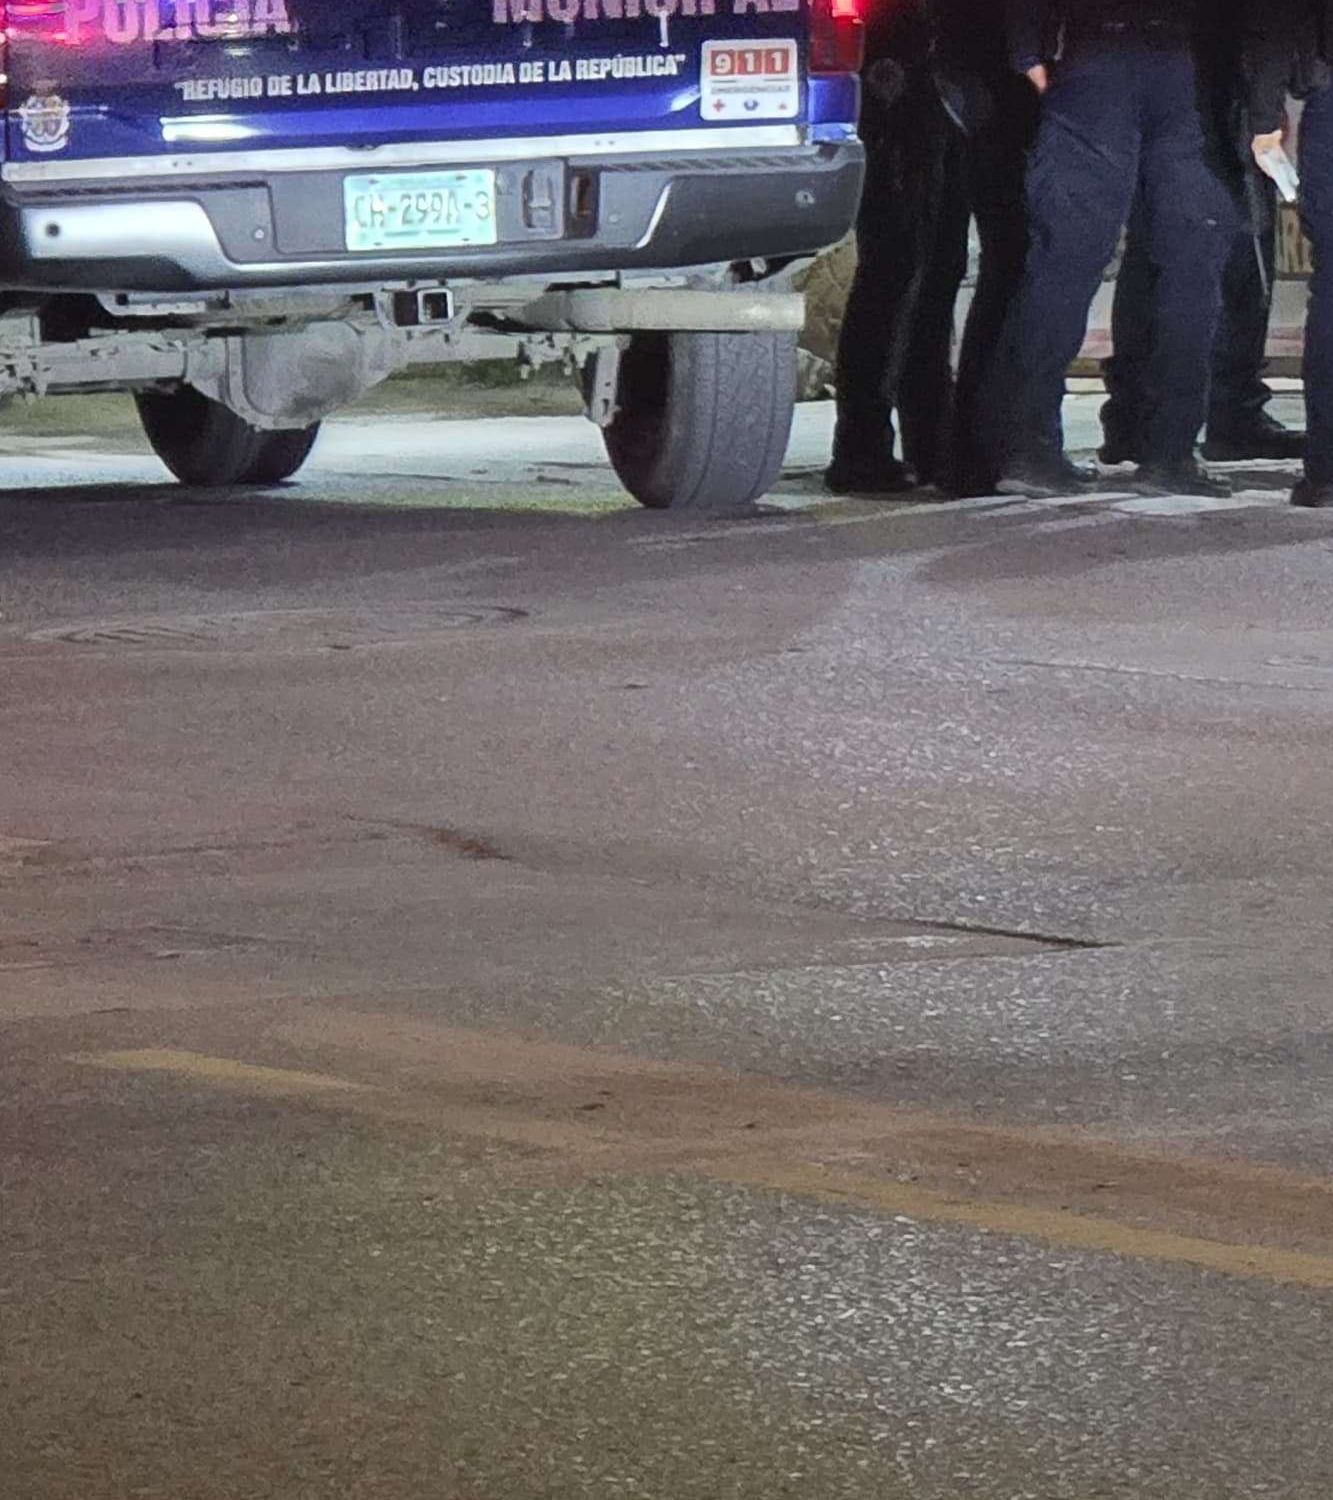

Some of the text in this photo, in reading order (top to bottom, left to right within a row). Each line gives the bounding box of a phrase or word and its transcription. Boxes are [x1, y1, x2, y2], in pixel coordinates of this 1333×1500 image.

[714, 49, 786, 74] 911
[267, 75, 293, 96] DE
[297, 73, 321, 95] LA
[325, 68, 420, 93] LIBERTAD,
[423, 63, 516, 88] CUSTODIA
[519, 61, 545, 83] DE
[548, 60, 573, 82] LA
